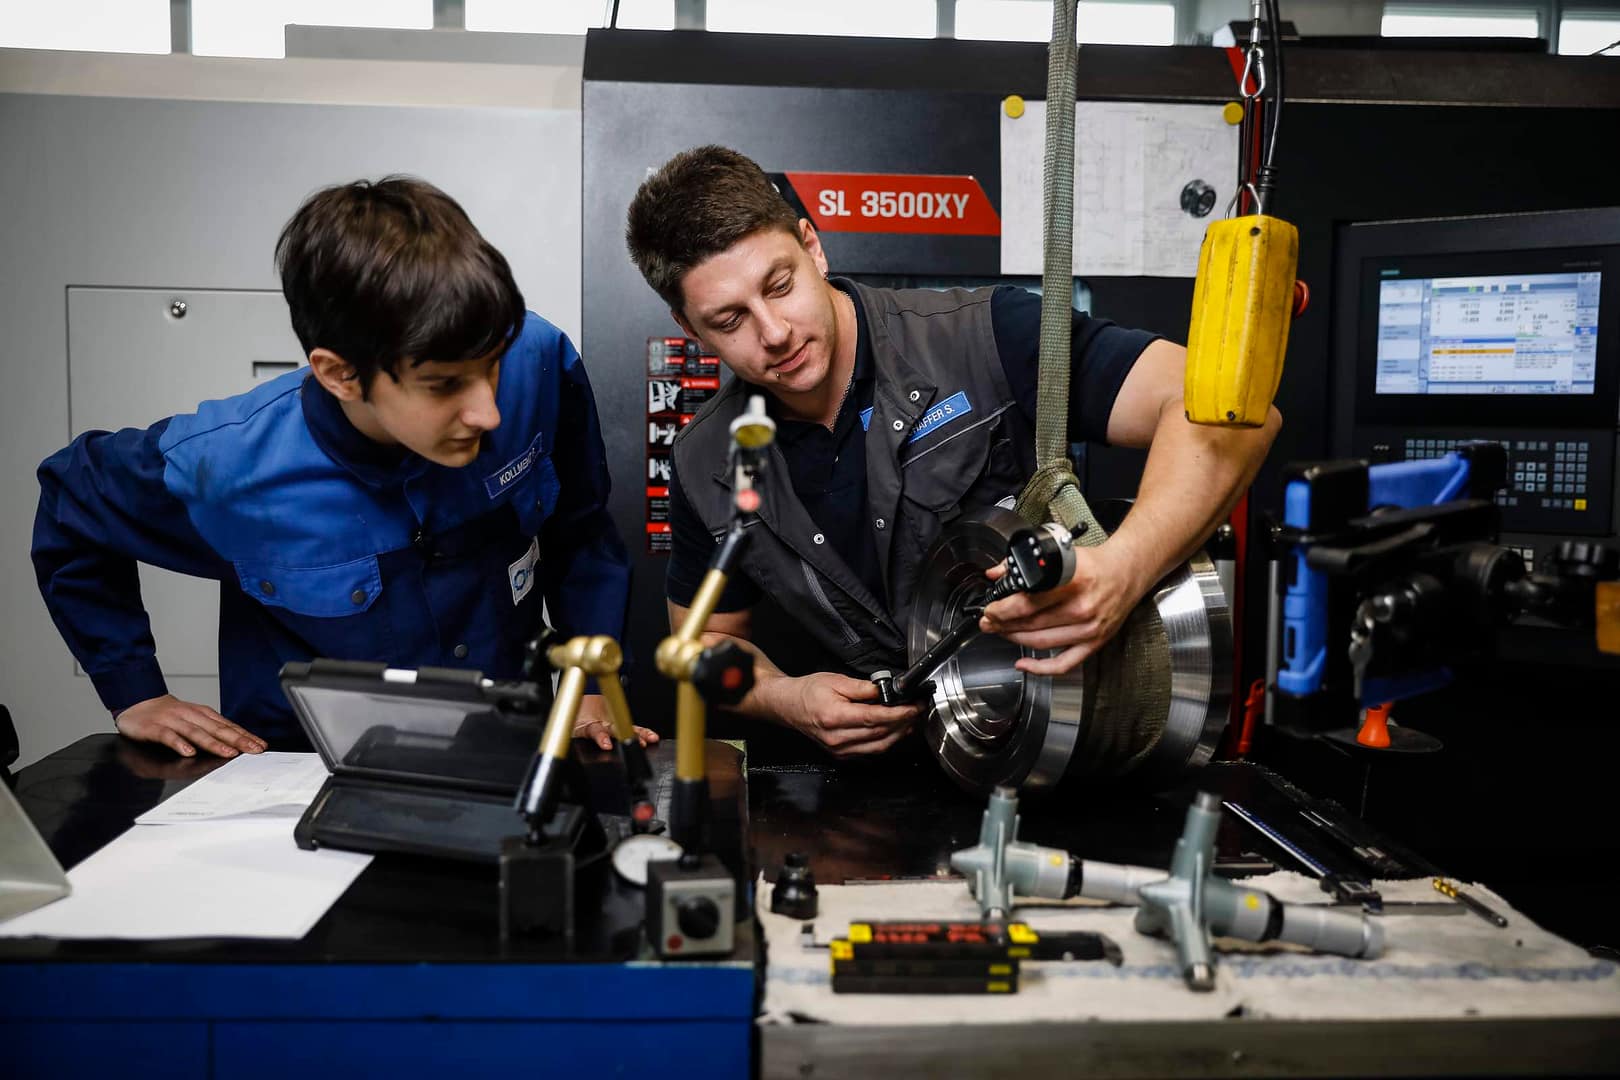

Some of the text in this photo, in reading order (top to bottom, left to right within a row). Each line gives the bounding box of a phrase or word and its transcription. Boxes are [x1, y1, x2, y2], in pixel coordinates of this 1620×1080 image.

[819, 189, 969, 219] SL 3500XY
[944, 404, 955, 414] S.
